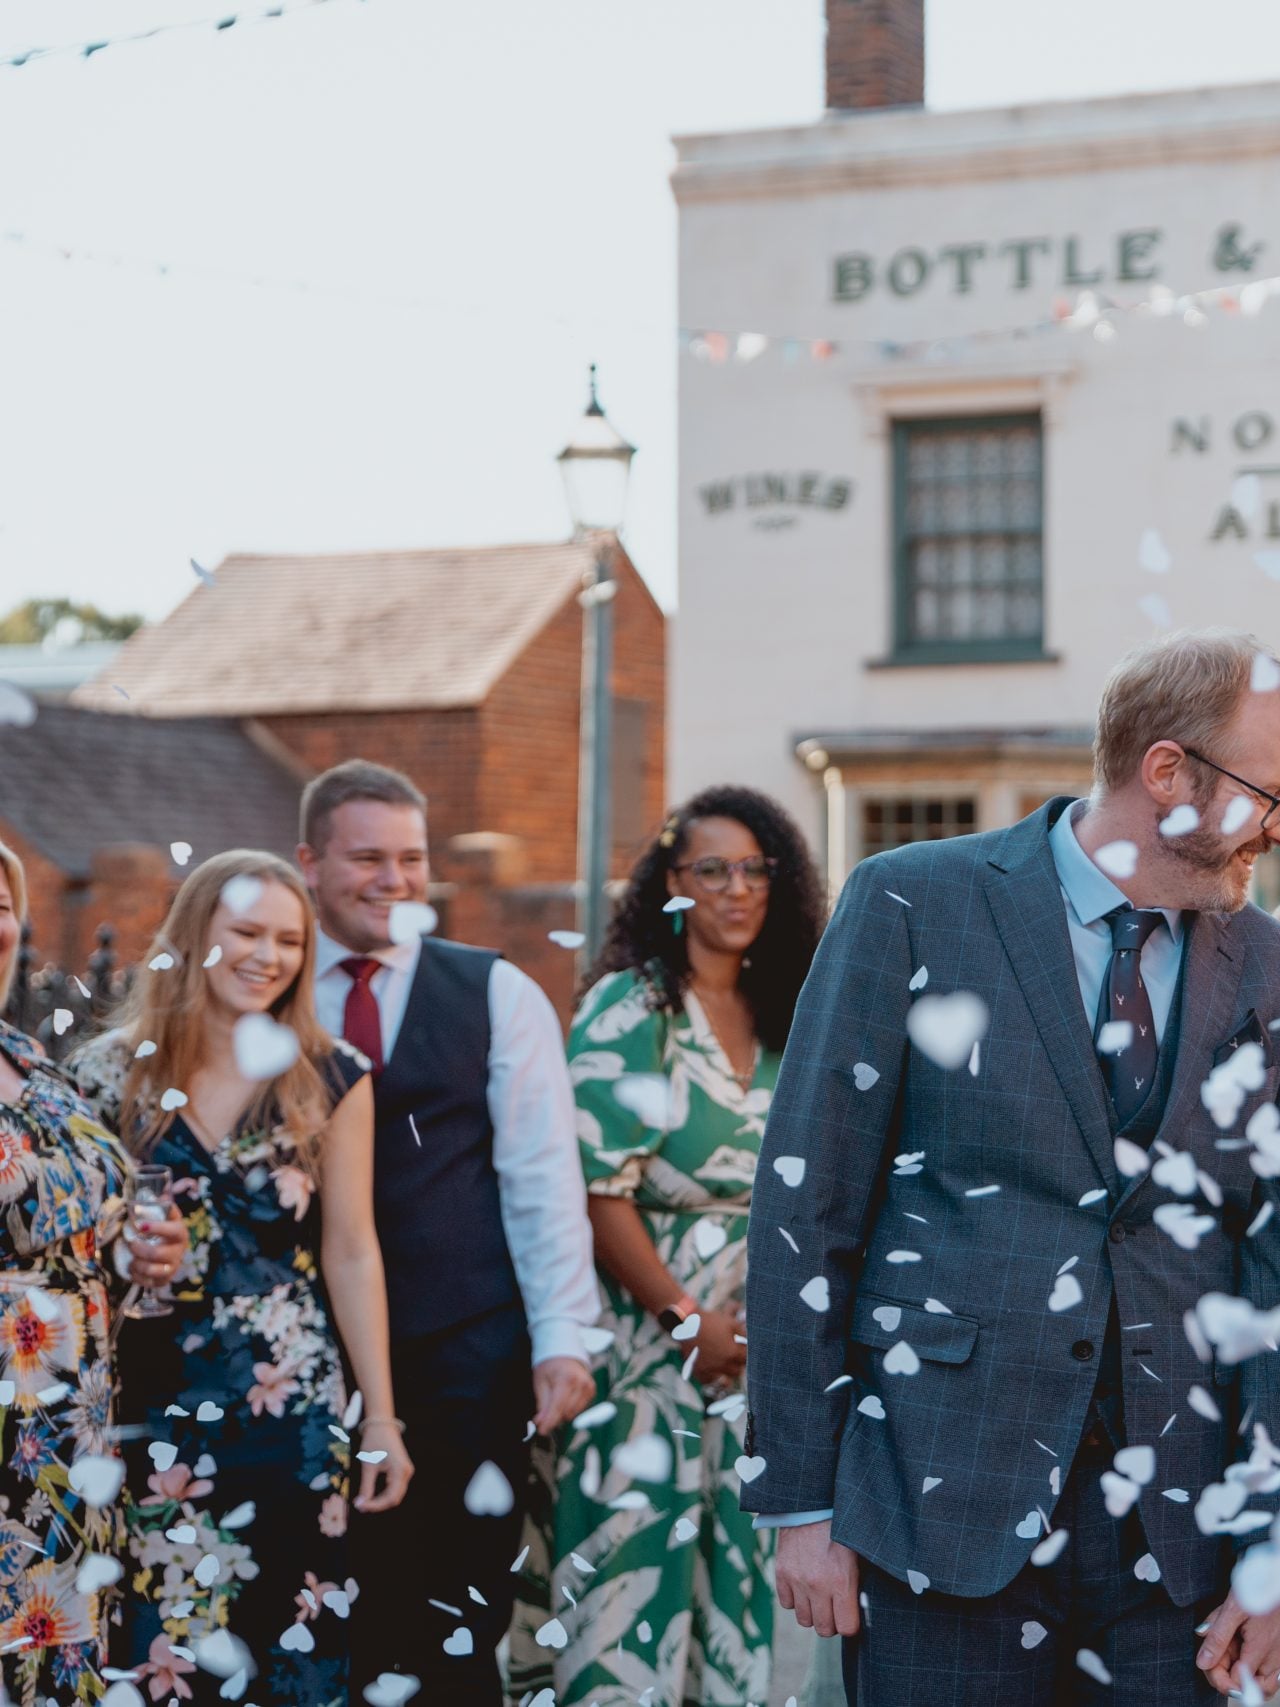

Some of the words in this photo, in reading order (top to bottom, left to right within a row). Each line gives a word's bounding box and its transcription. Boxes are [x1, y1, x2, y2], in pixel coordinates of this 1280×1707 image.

[832, 225, 1162, 304] BOTTLE
[1212, 219, 1266, 275] &
[698, 470, 856, 516] WINES
